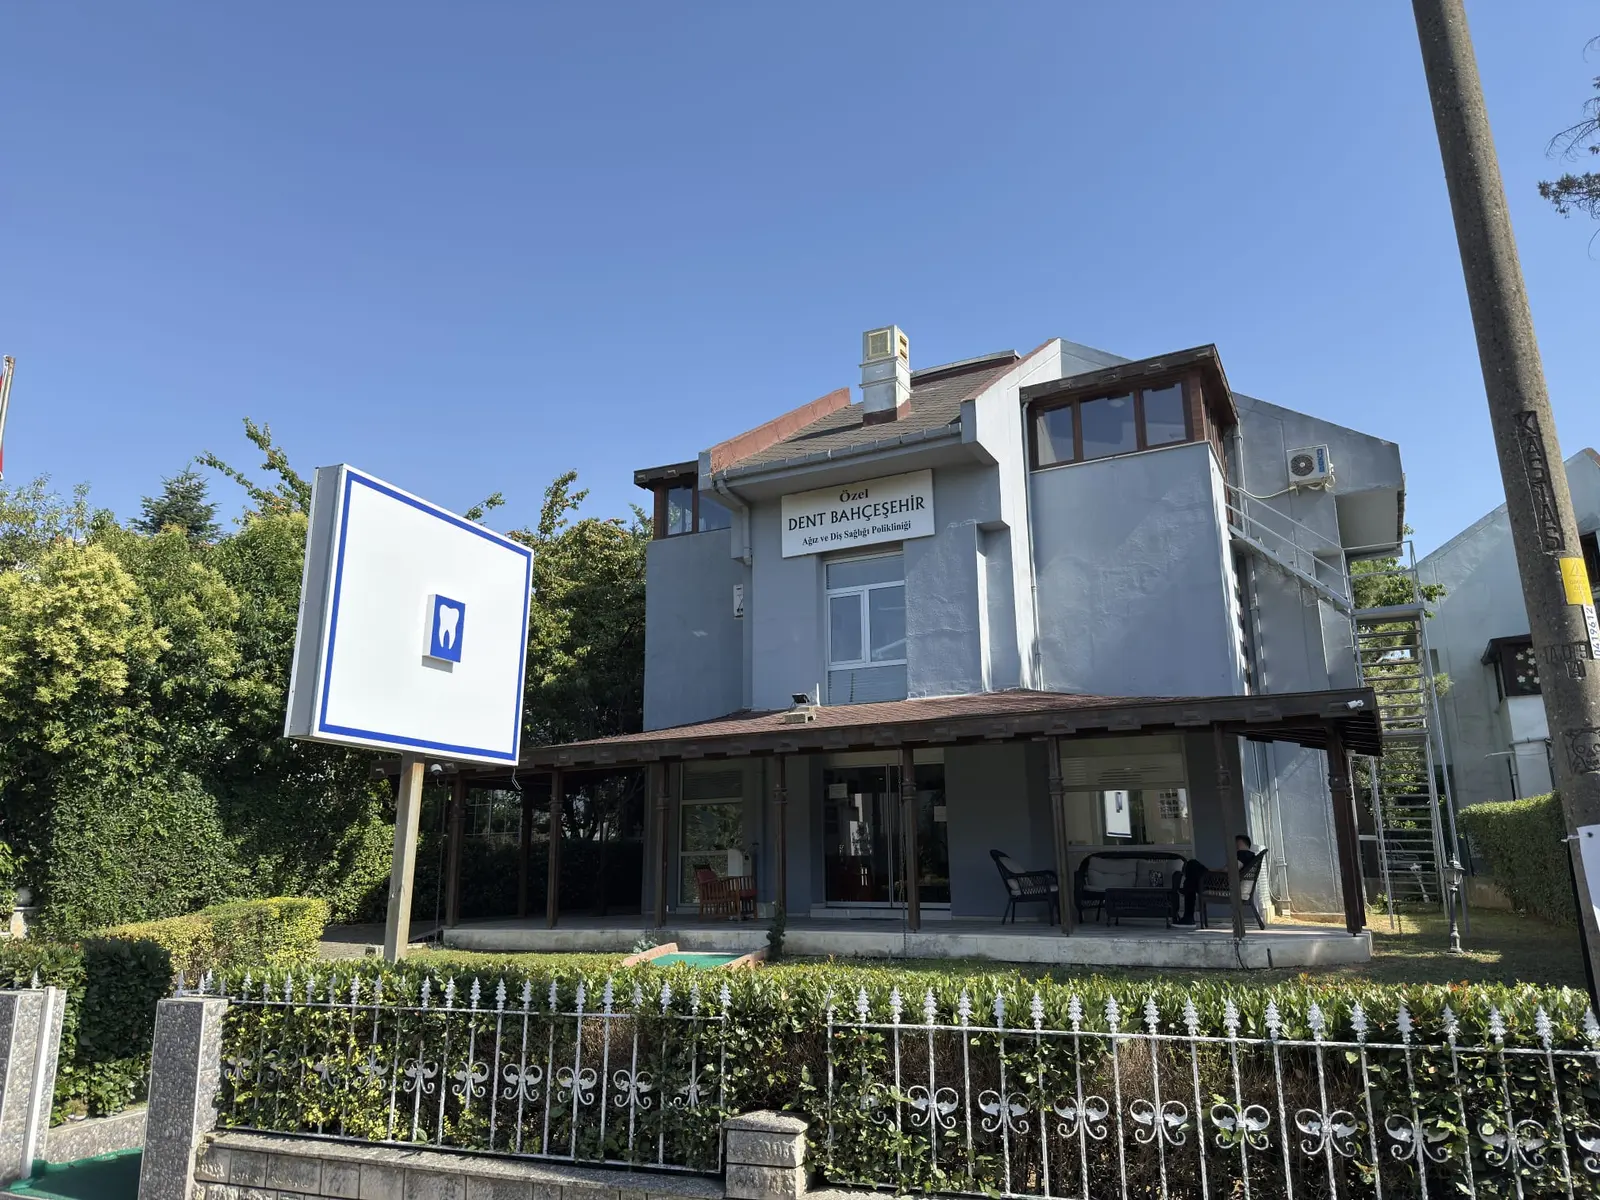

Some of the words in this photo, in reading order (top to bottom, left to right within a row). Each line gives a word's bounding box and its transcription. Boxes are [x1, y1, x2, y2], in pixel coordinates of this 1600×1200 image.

[839, 488, 869, 503] Özel
[788, 512, 826, 531] DENT
[831, 494, 925, 524] BAHÇEŞEHİR
[802, 536, 819, 546] Ağız
[820, 535, 829, 543] ve
[830, 531, 843, 541] Diş
[844, 528, 870, 539] Sağlığı
[872, 520, 911, 535] Polikliniği
